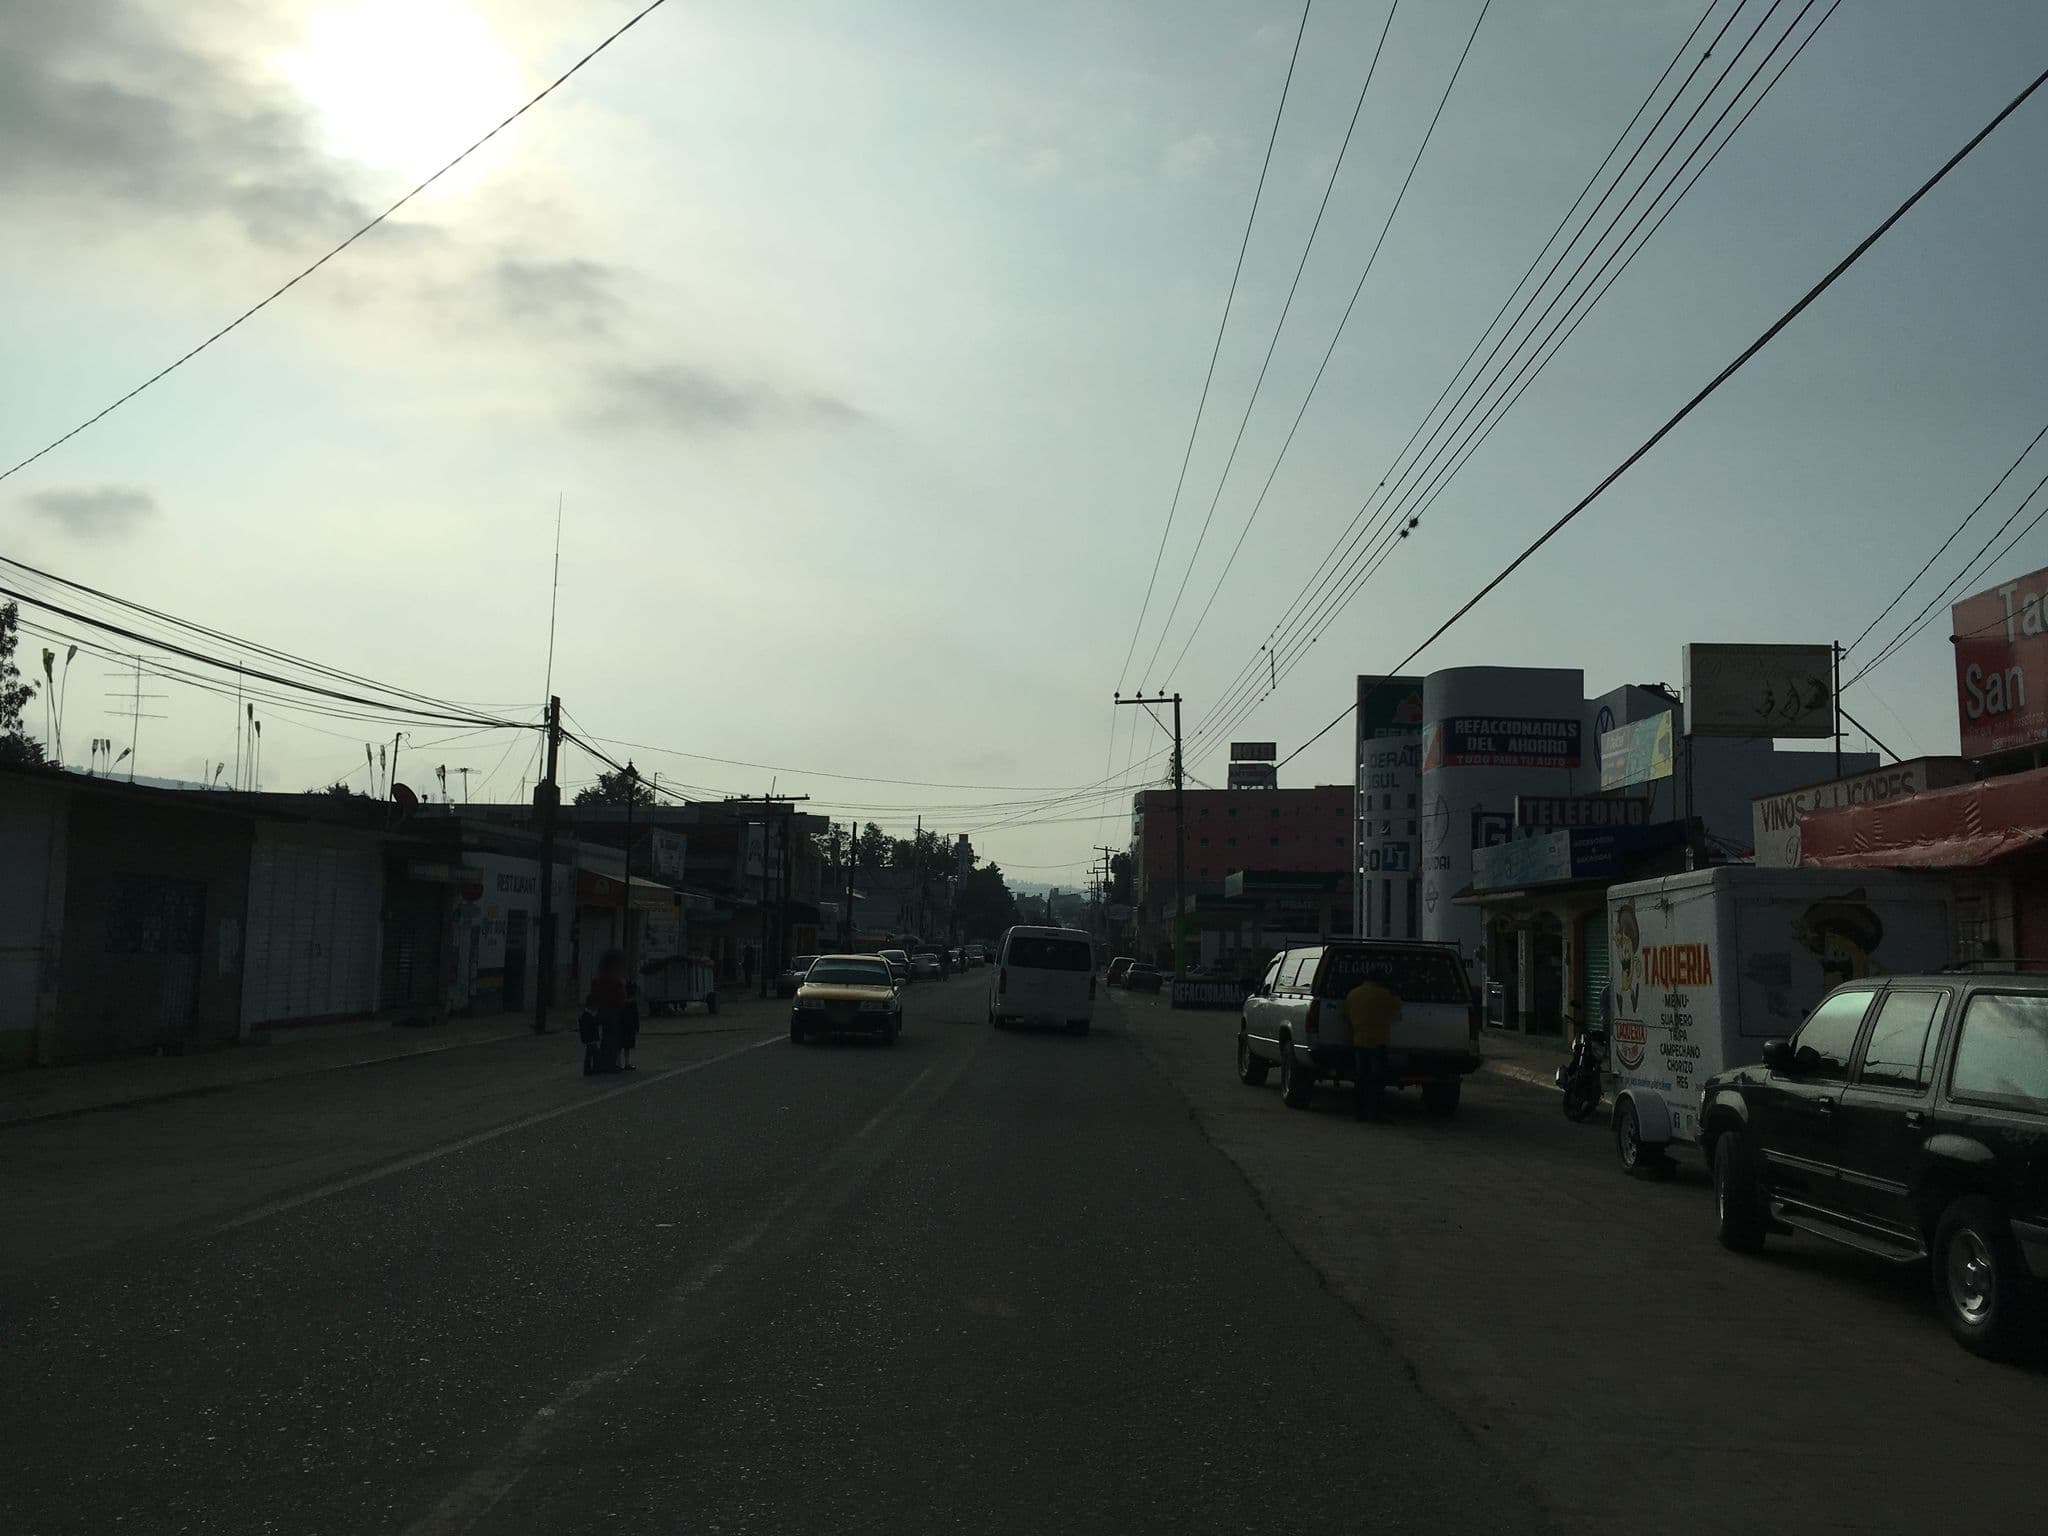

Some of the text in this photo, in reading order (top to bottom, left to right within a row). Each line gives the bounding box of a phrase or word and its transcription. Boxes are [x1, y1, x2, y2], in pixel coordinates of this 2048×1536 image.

[1966, 663, 2025, 719] San
[1455, 720, 1577, 737] REFACCIONARIAS
[1467, 736, 1568, 754] DEL AHORRO
[1523, 799, 1643, 825] TELEFONO
[1760, 794, 1806, 832] VINOS
[1642, 944, 1713, 989] TAQUERIA
[1659, 1043, 1701, 1059] CAMPECHANO
[1666, 1061, 1694, 1073] CHORIZO
